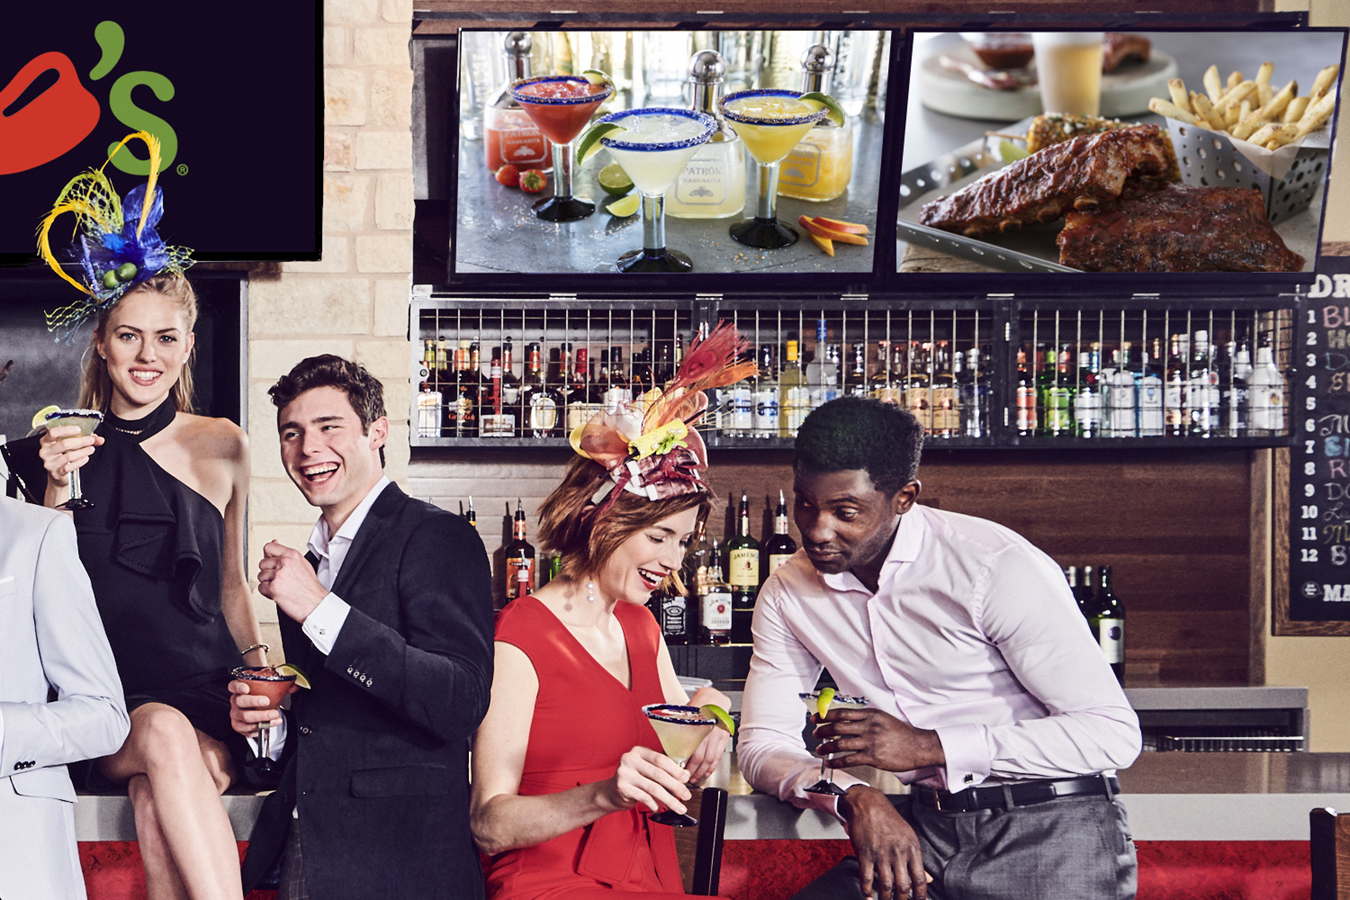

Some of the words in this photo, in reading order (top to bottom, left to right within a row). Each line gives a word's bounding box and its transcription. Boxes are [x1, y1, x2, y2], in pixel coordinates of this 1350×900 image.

[1307, 310, 1316, 324] 1
[1306, 331, 1317, 346] 2
[1306, 353, 1316, 367] 3
[1305, 375, 1317, 389] 4
[1306, 396, 1316, 411] 5
[1305, 418, 1316, 433] 6
[1305, 440, 1316, 454] 7
[1304, 461, 1316, 476] 8
[1304, 483, 1316, 498] 9
[1301, 505, 1319, 519] 10
[1301, 526, 1318, 541] 11
[1300, 548, 1319, 563] 12
